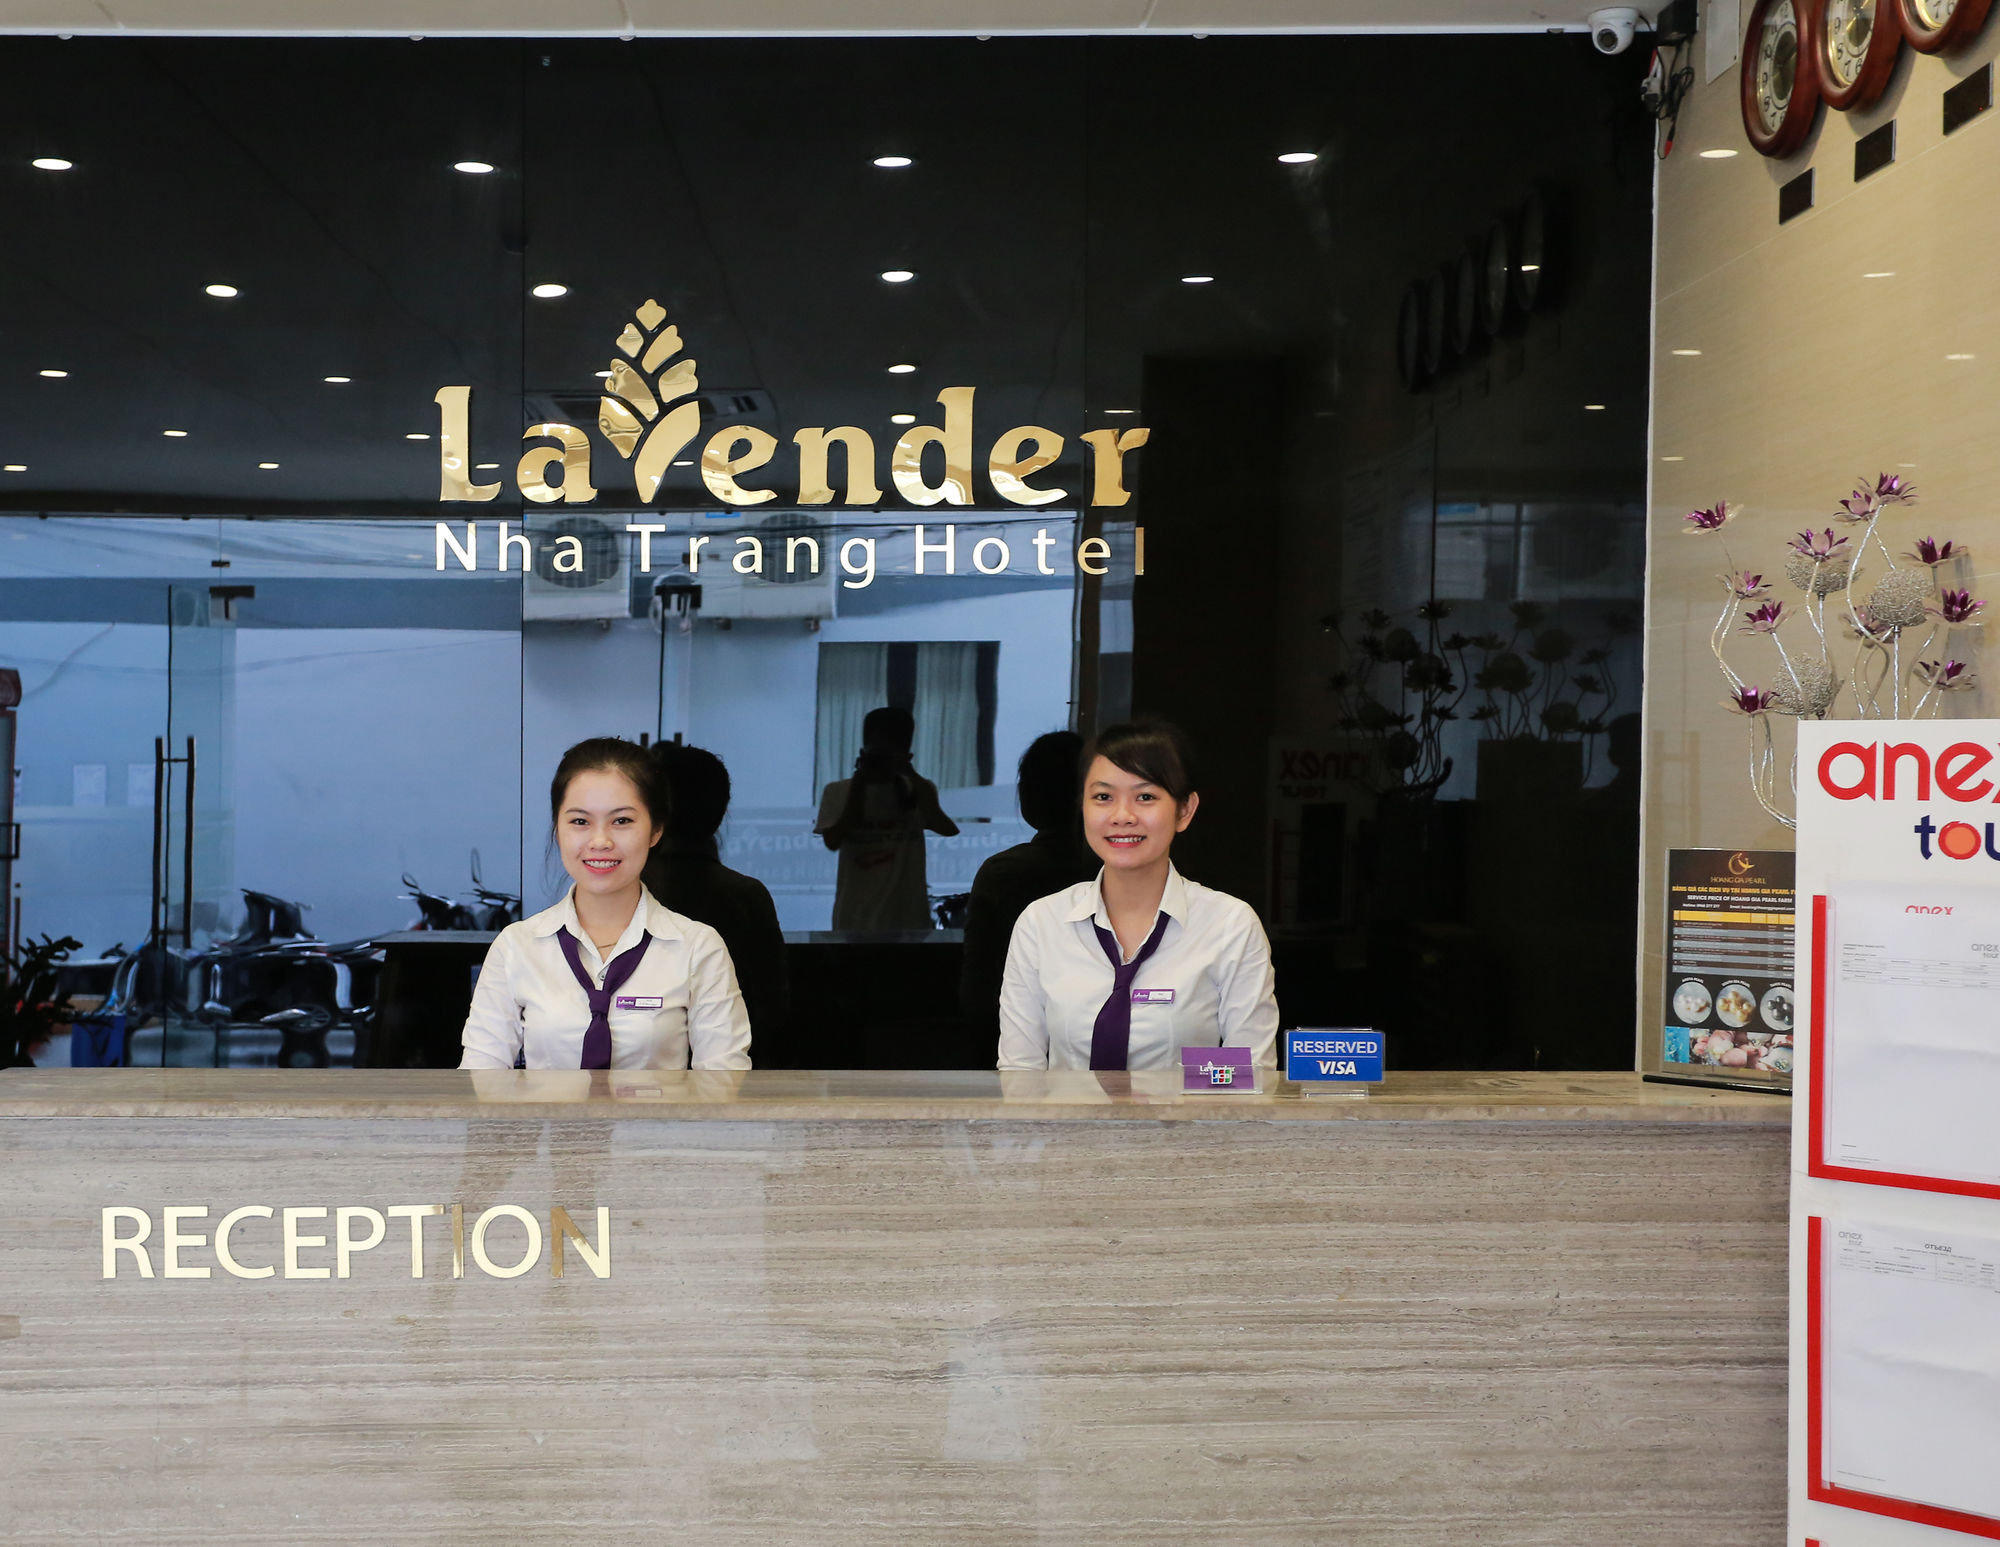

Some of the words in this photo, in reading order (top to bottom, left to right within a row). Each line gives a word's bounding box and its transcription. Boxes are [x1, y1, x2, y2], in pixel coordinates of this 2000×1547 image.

[434, 386, 1151, 507] Lavender
[433, 522, 584, 574] Nha
[626, 523, 877, 589] Trang
[914, 523, 1145, 576] Hotel
[1818, 741, 2000, 804] ane
[1292, 1040, 1378, 1054] RESERVED
[1316, 1060, 1357, 1075] VISA
[101, 1204, 612, 1279] RECEPTION
